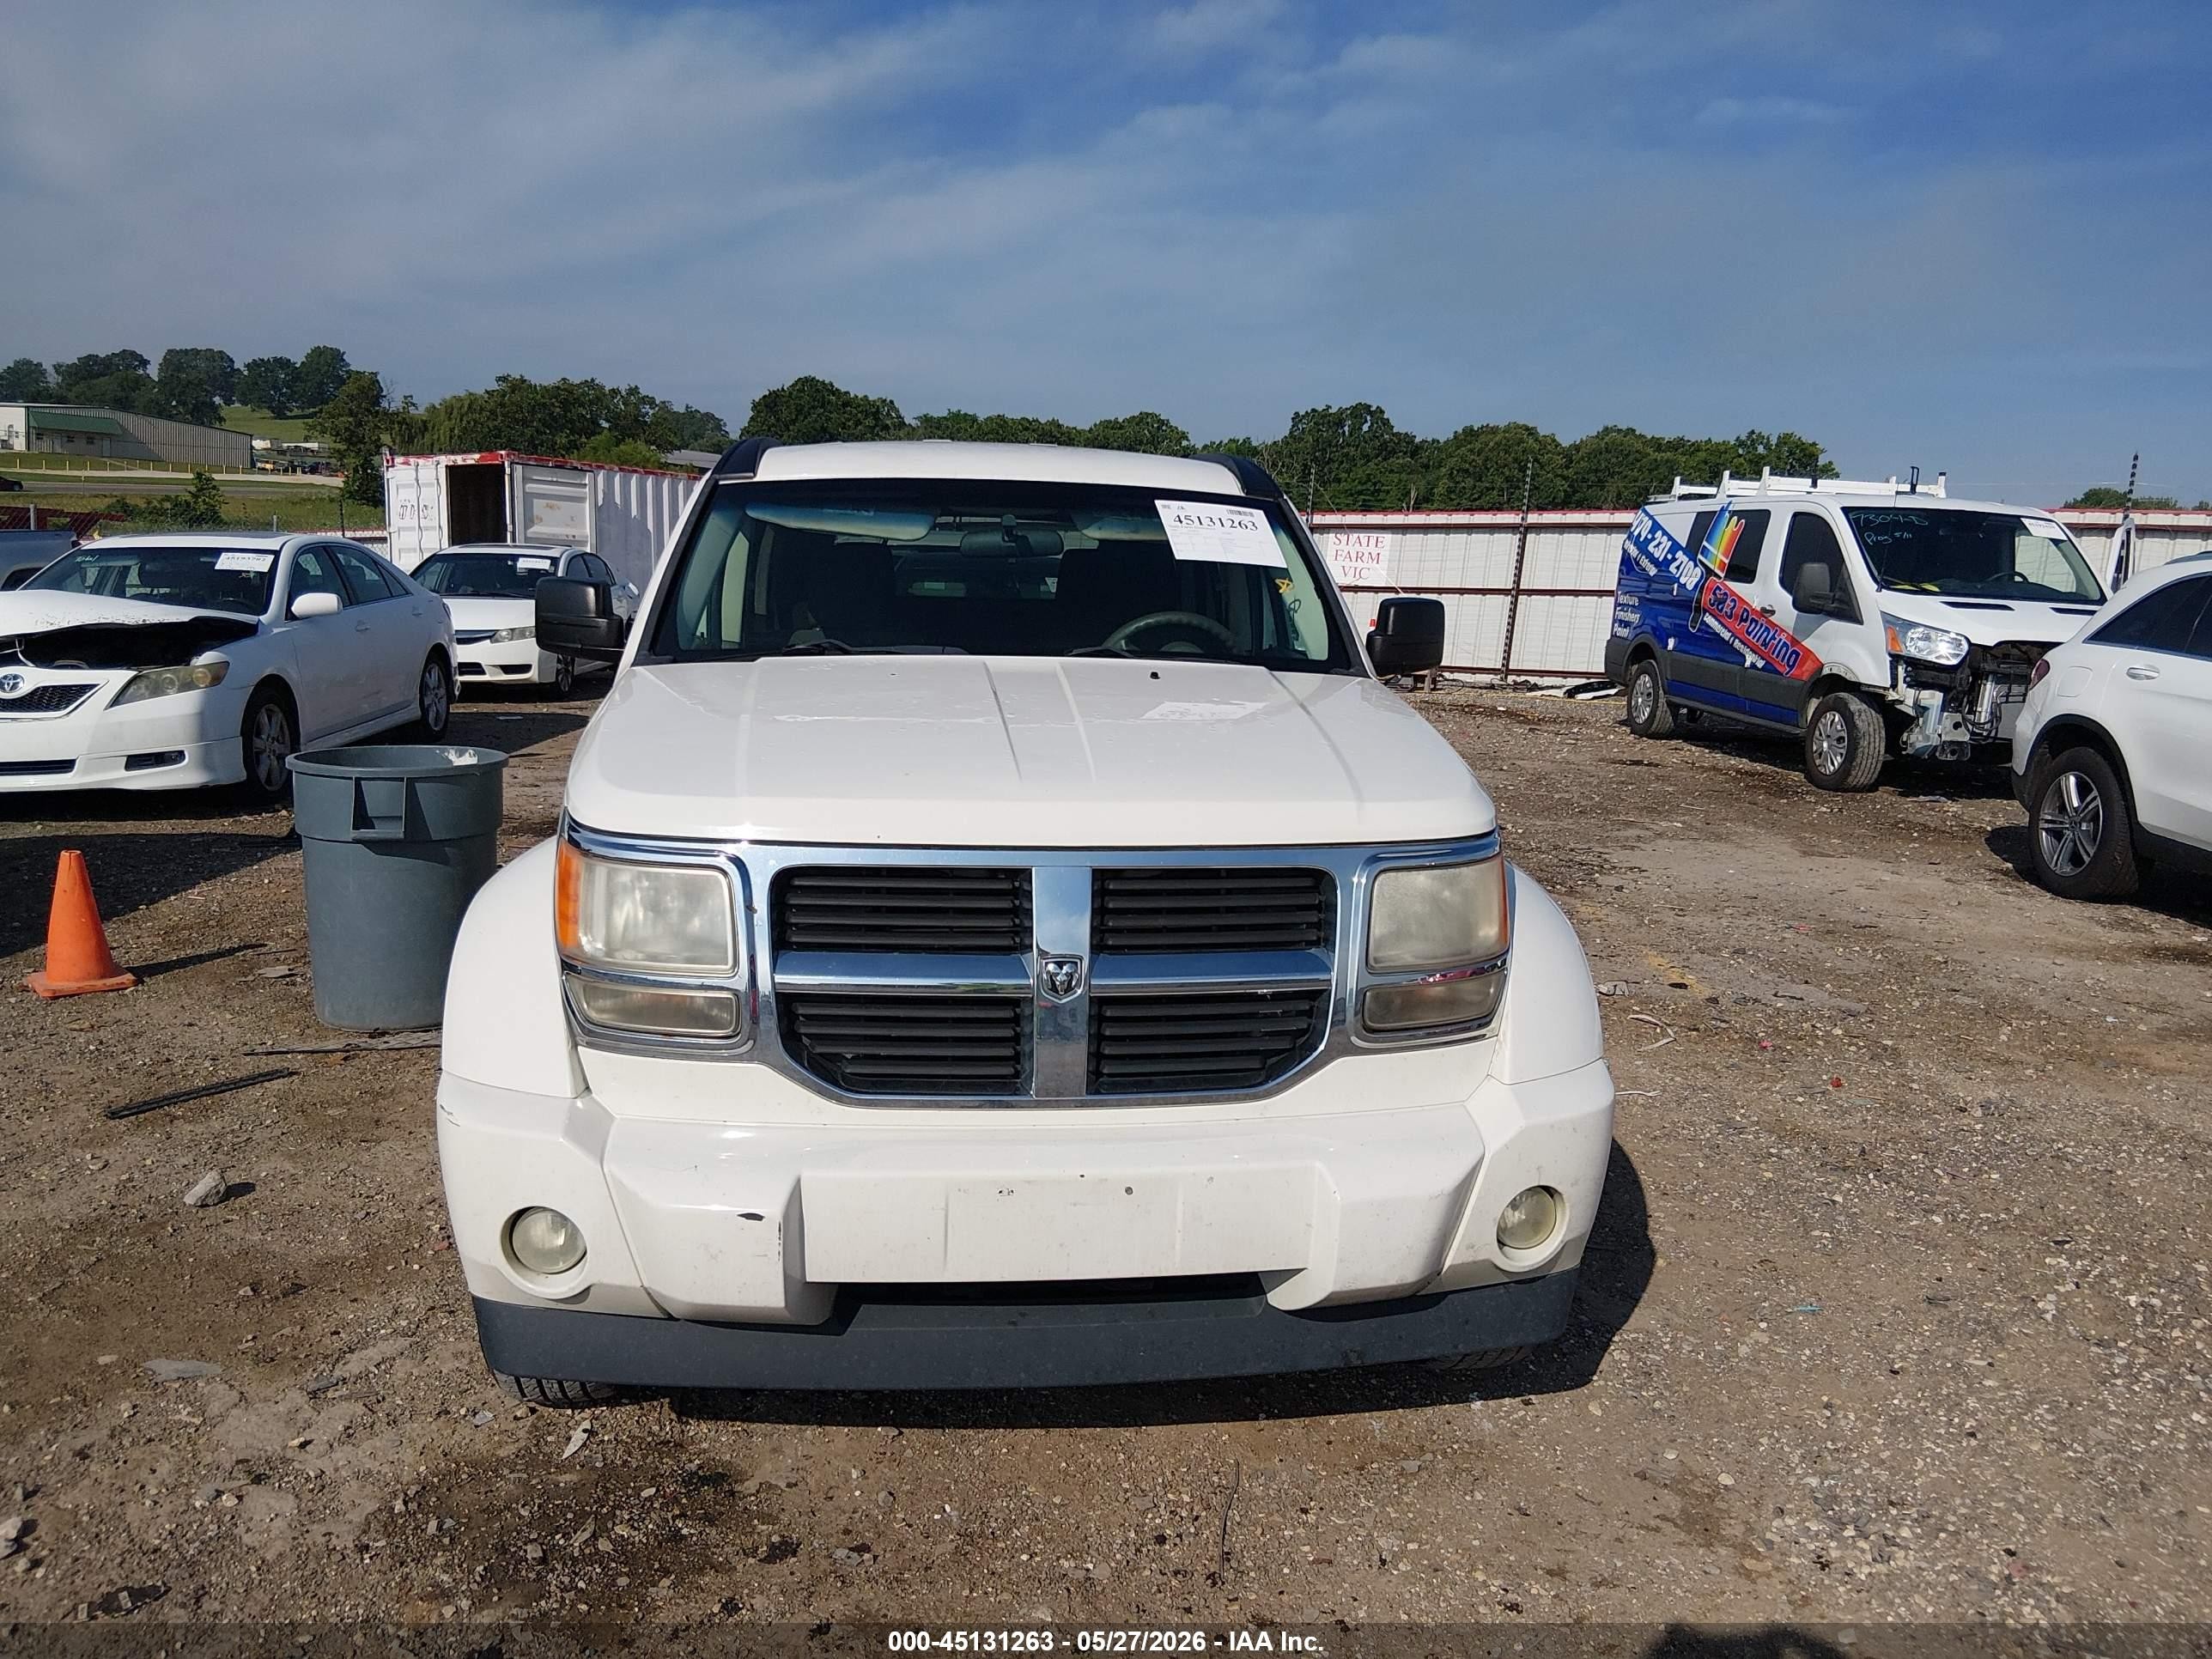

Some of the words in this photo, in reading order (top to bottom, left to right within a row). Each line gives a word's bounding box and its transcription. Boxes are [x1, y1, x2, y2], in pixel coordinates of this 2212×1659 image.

[1173, 514, 1259, 532] 45131263
[1333, 532, 1386, 550] STATE
[1333, 549, 1382, 564] FARM
[1631, 510, 1702, 591] 479-231-2708
[1340, 565, 1371, 580] VIC
[1617, 591, 1639, 606] Texture
[1613, 623, 1630, 638] Paint
[1735, 605, 1803, 677] Painting
